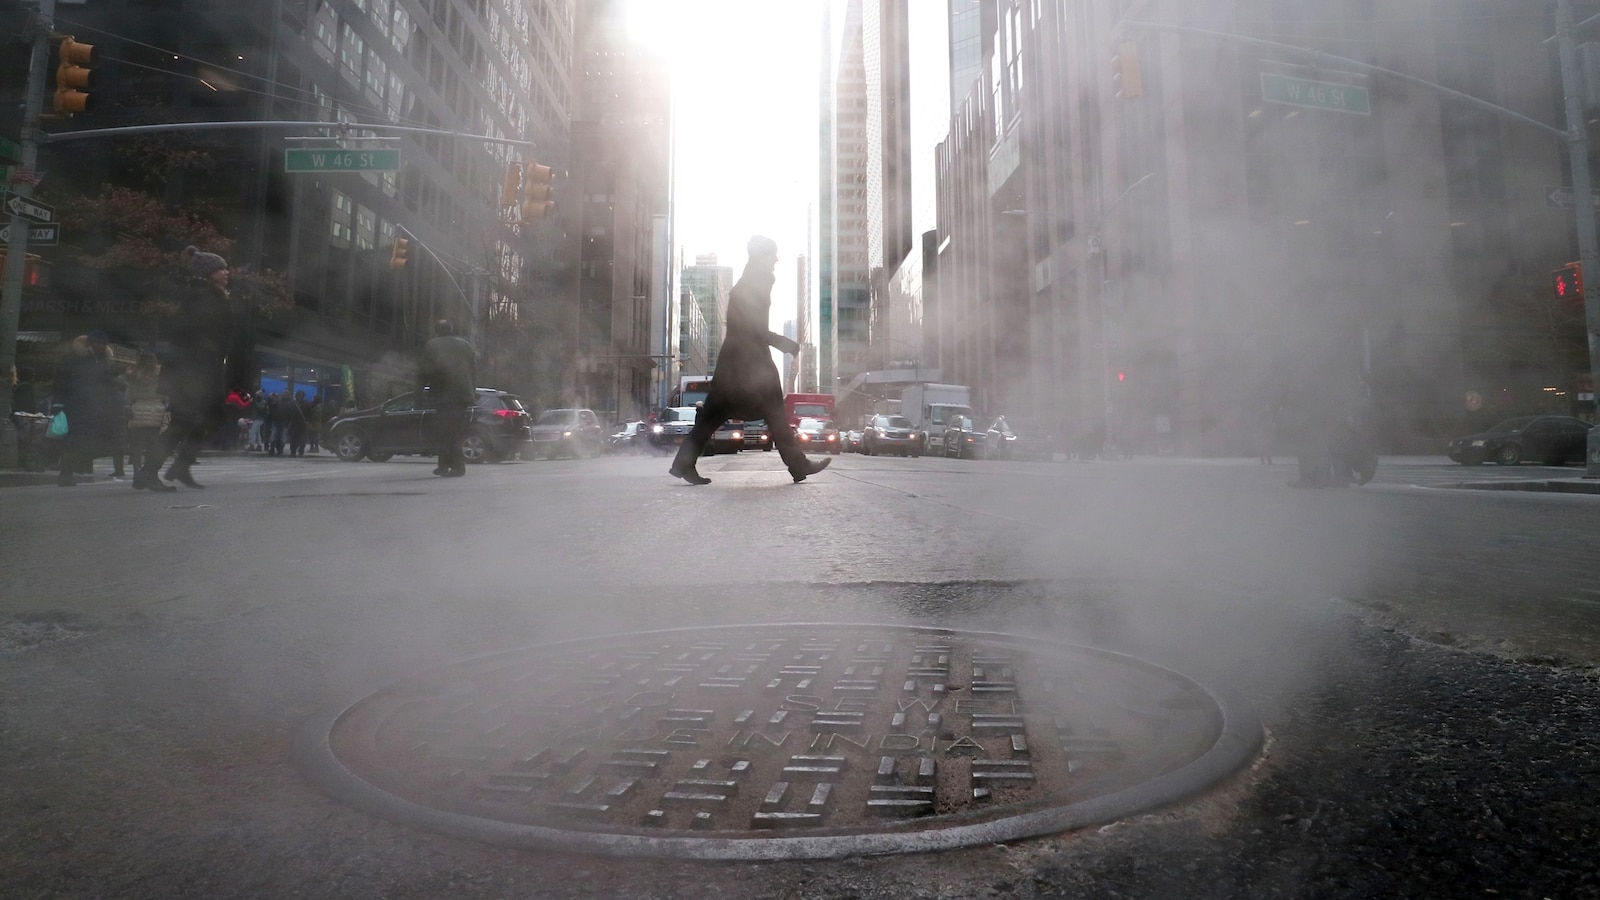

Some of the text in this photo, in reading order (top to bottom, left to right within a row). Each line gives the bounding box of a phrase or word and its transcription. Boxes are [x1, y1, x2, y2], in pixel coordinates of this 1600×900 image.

[1287, 82, 1346, 106] W 46 St
[312, 153, 375, 167] W 46 St
[12, 200, 48, 219] ONE WAY
[727, 729, 791, 746] IN
[810, 732, 985, 751] INDIA
